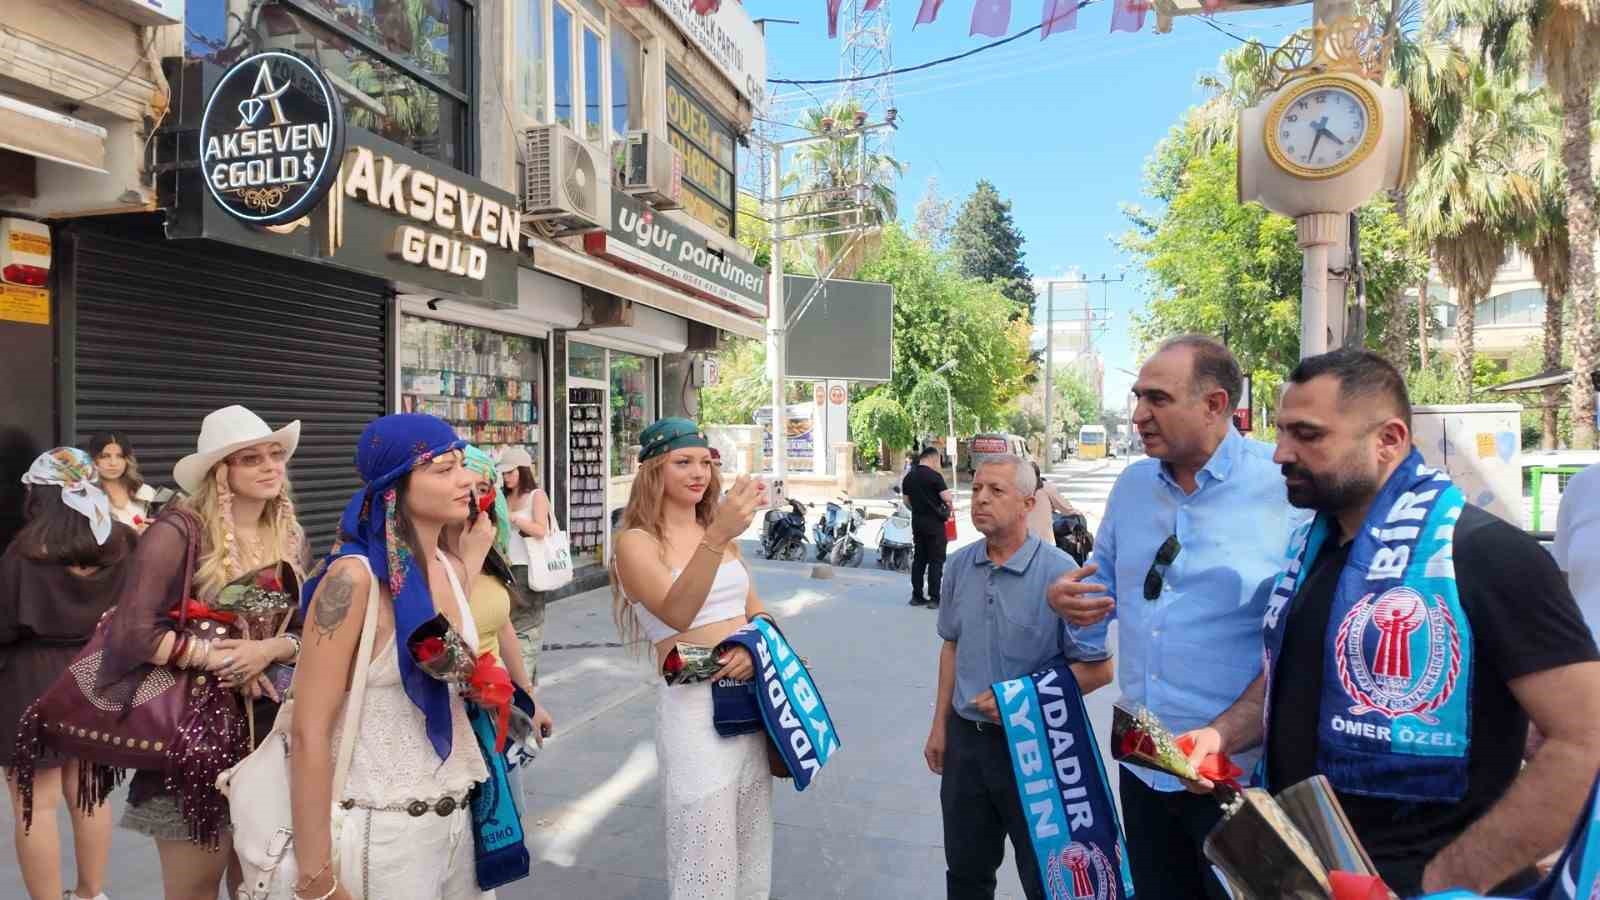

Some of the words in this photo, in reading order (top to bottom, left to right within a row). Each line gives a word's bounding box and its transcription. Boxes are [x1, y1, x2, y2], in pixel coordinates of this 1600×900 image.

[205, 122, 328, 161] AKSEVEN
[345, 146, 521, 252] AKSEVEN
[402, 225, 488, 281] GOLD
[1365, 488, 1440, 580] BİR
[1035, 668, 1094, 833] VDADIR
[1331, 714, 1392, 742] ÖMER
[1399, 724, 1457, 747] ÖZEL
